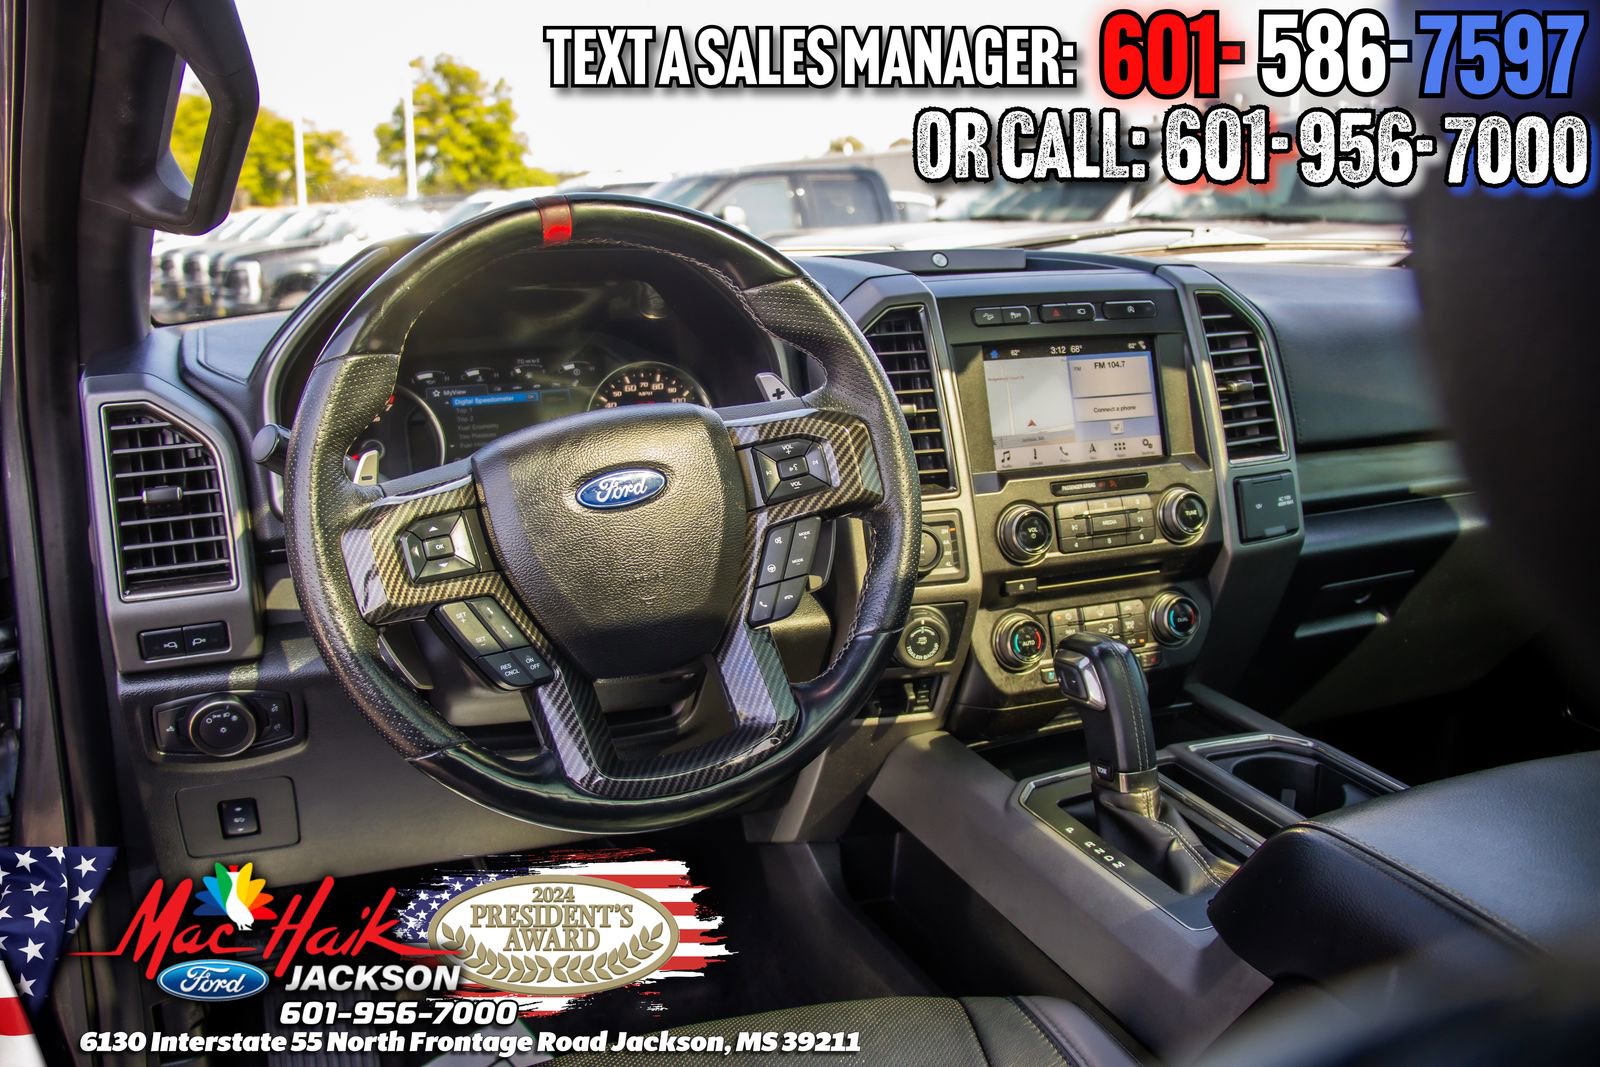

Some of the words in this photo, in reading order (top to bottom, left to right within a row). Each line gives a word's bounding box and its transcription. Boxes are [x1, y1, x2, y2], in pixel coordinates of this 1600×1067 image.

[1050, 346, 1066, 355] 3:12
[1094, 361, 1106, 369] FM
[1108, 360, 1126, 369] 104.7
[624, 384, 637, 392] 60
[651, 382, 664, 391] 80
[443, 389, 467, 398] MyView
[454, 397, 474, 406] Digital
[475, 395, 515, 405] Speedometer
[782, 443, 794, 451] VOL
[790, 480, 803, 488] VOL
[596, 476, 648, 503] Ford
[435, 543, 445, 551] OK
[456, 611, 467, 620] SET
[475, 636, 486, 644] SET
[1022, 639, 1036, 647] AUTO
[906, 645, 923, 660] TRAILER
[923, 642, 939, 660] BACKUP
[525, 656, 535, 664] ON
[500, 662, 512, 671] RES
[529, 662, 541, 670] OFF
[504, 668, 520, 677] CNCL
